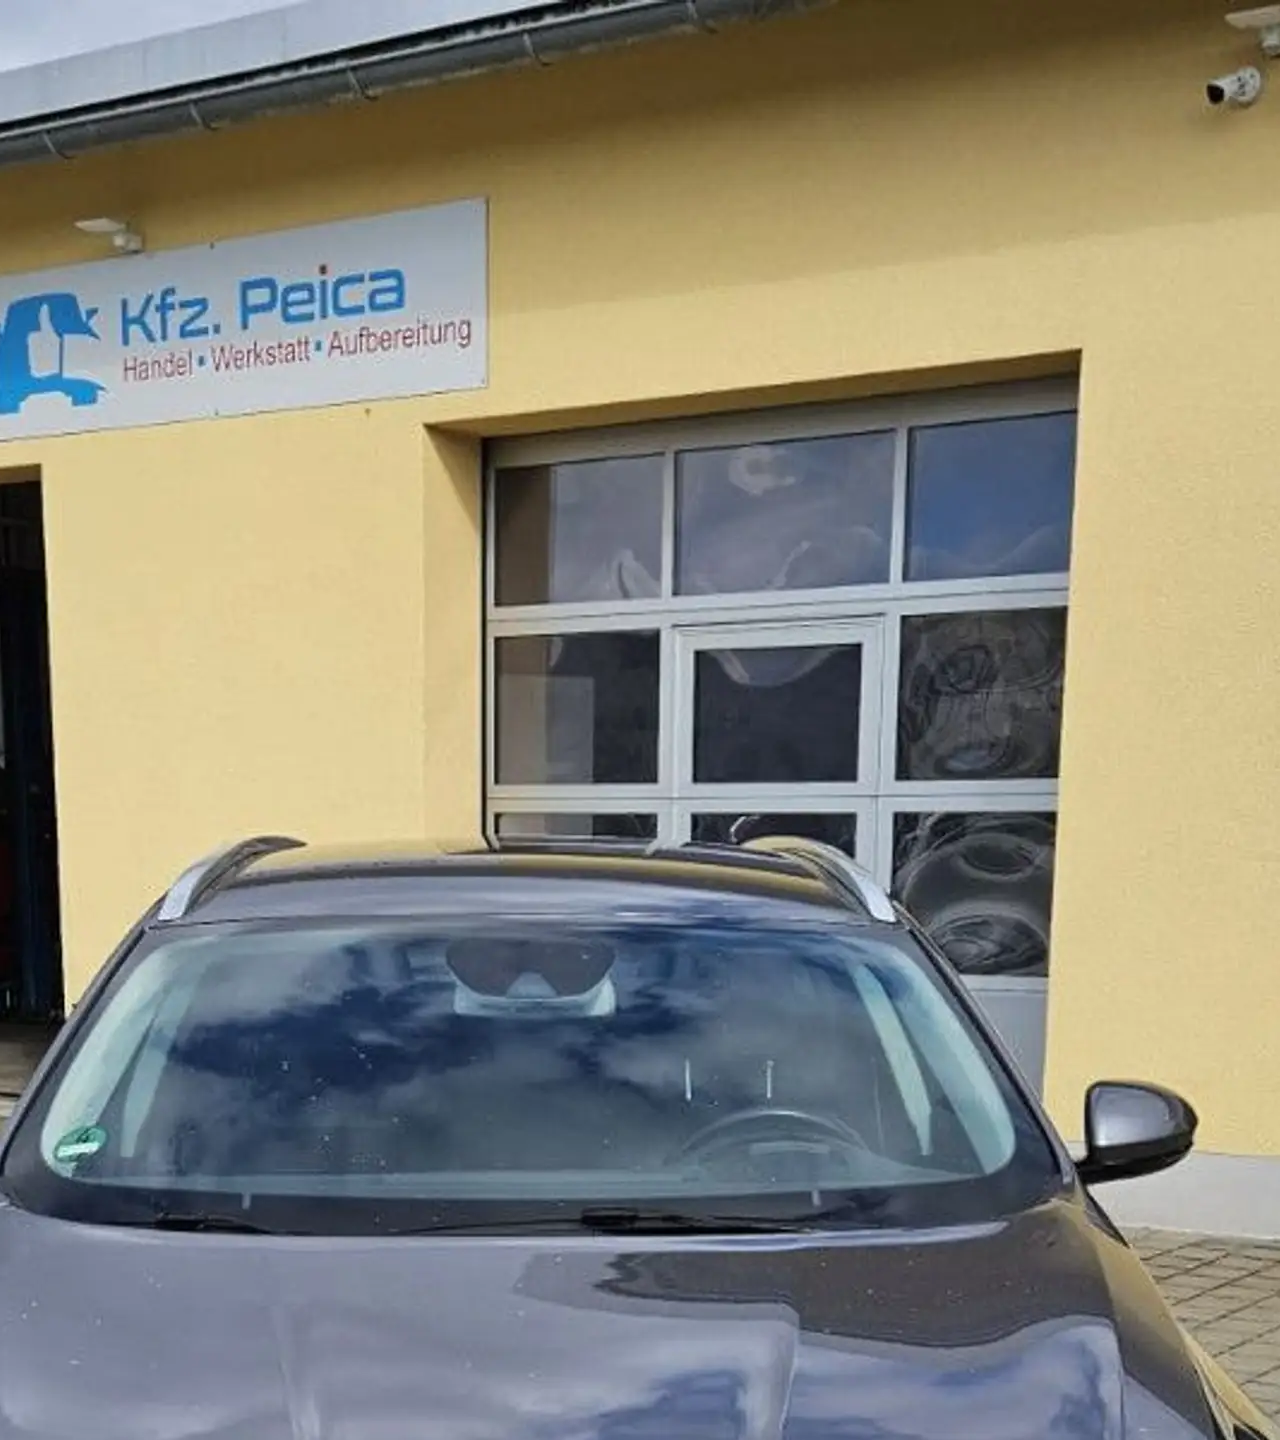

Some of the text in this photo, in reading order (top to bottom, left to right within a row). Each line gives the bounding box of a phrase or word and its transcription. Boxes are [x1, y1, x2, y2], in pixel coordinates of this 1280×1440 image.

[121, 264, 406, 346] Kfz. Peica
[123, 316, 472, 382] Handel Werkstatt Aufbereitung
